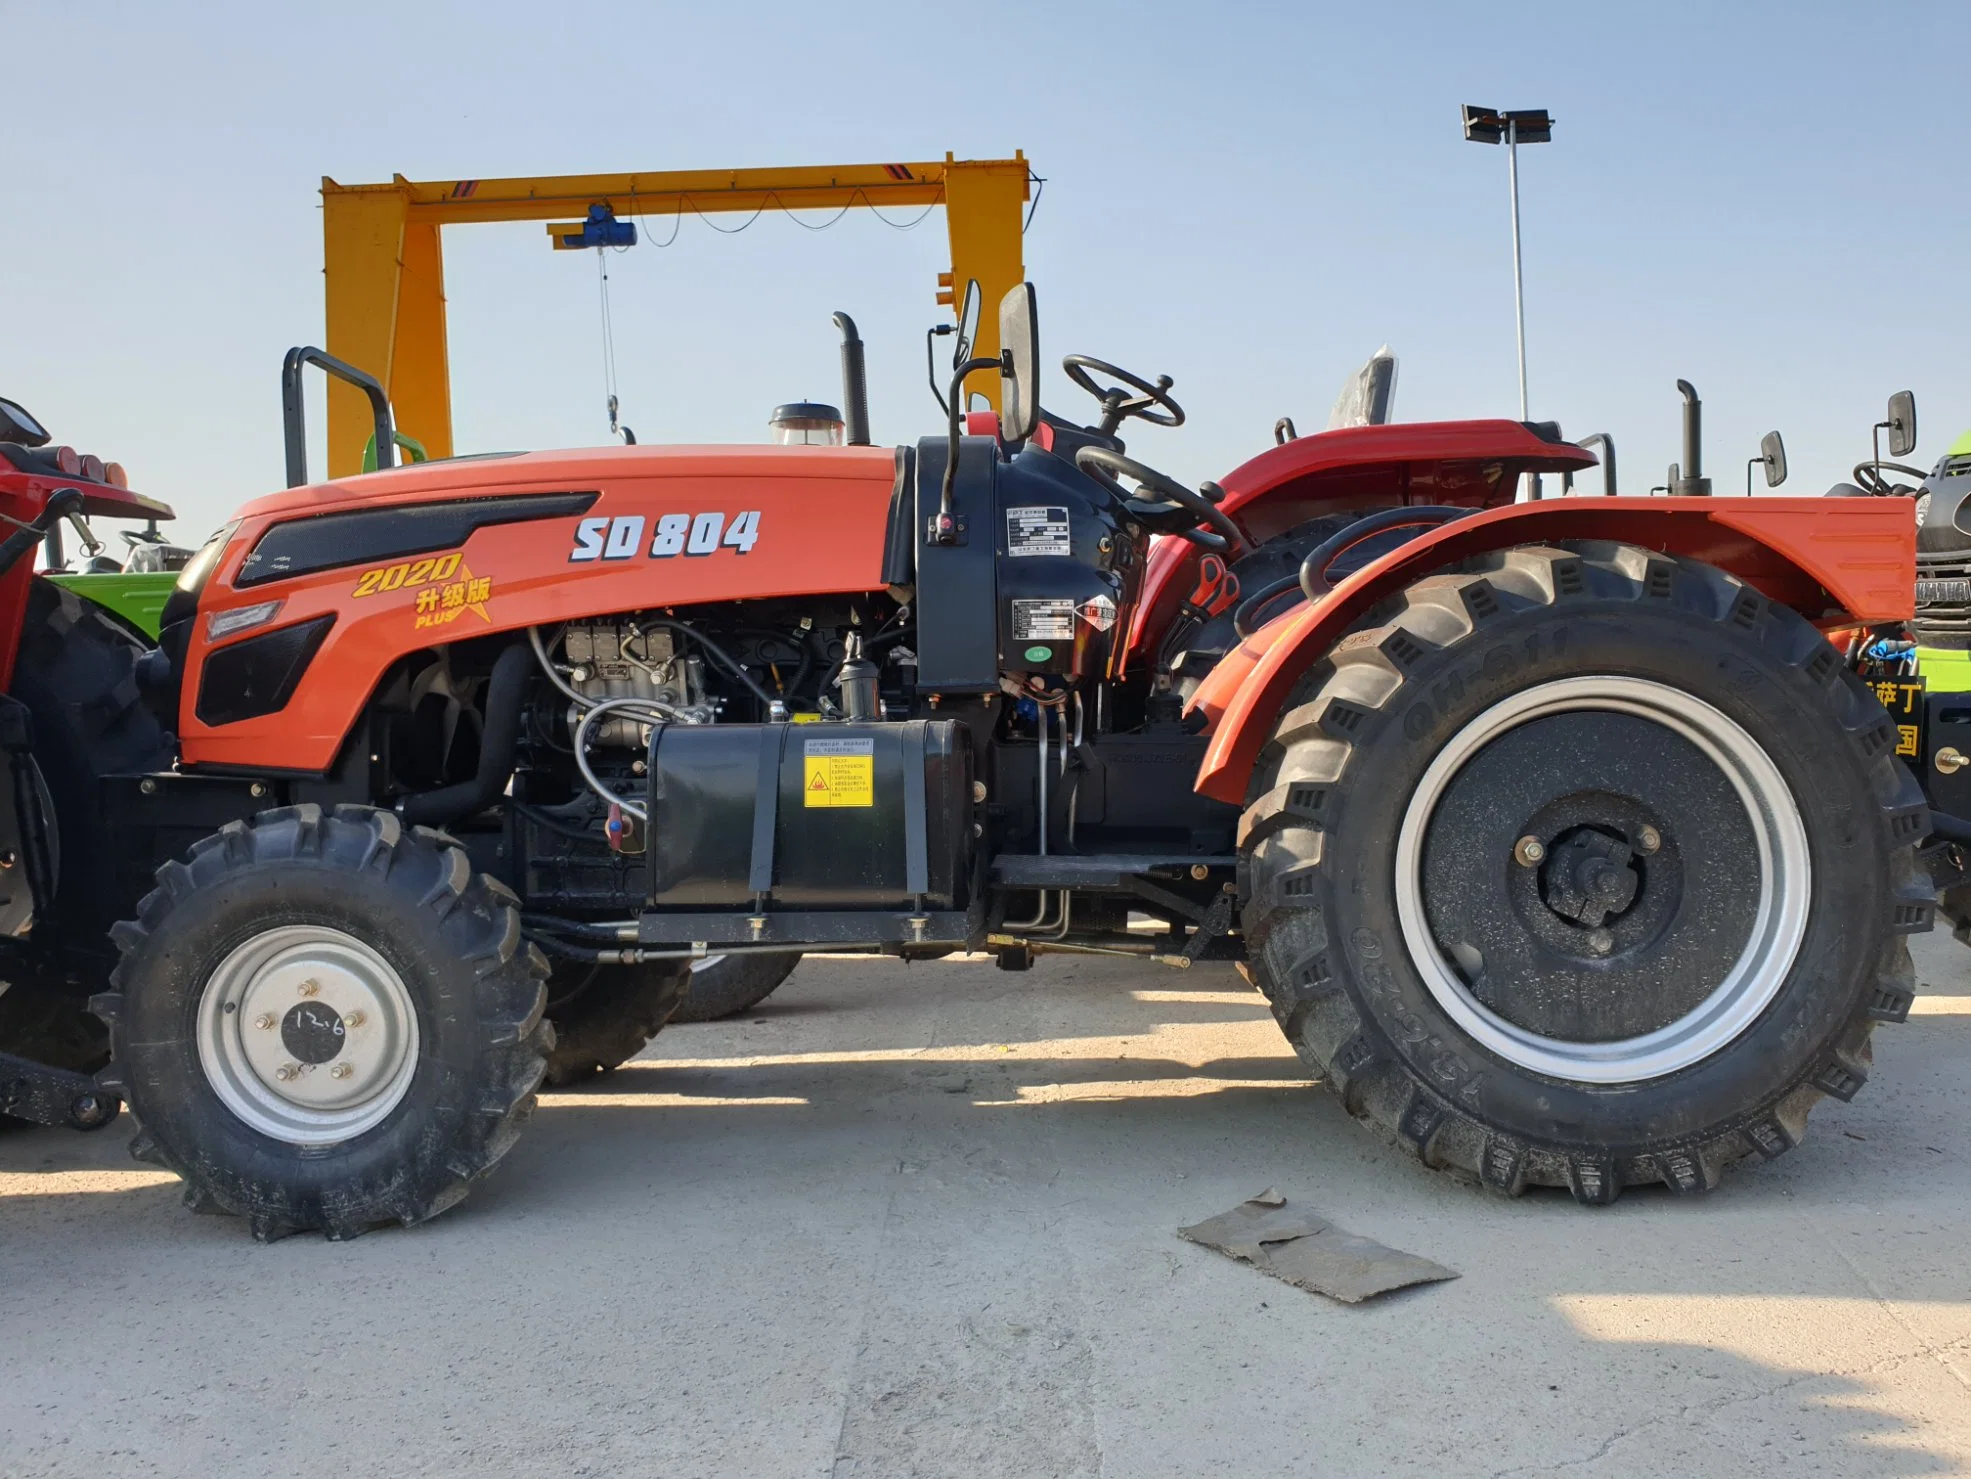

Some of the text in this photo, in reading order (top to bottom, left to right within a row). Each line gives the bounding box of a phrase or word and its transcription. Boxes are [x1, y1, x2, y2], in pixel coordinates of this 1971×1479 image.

[568, 510, 761, 563] SD 804
[351, 553, 464, 598] 2020
[416, 576, 492, 614] 升级版
[415, 610, 456, 629] PLUS
[1867, 682, 1922, 713] 萨丁
[297, 1009, 344, 1036] 12.6
